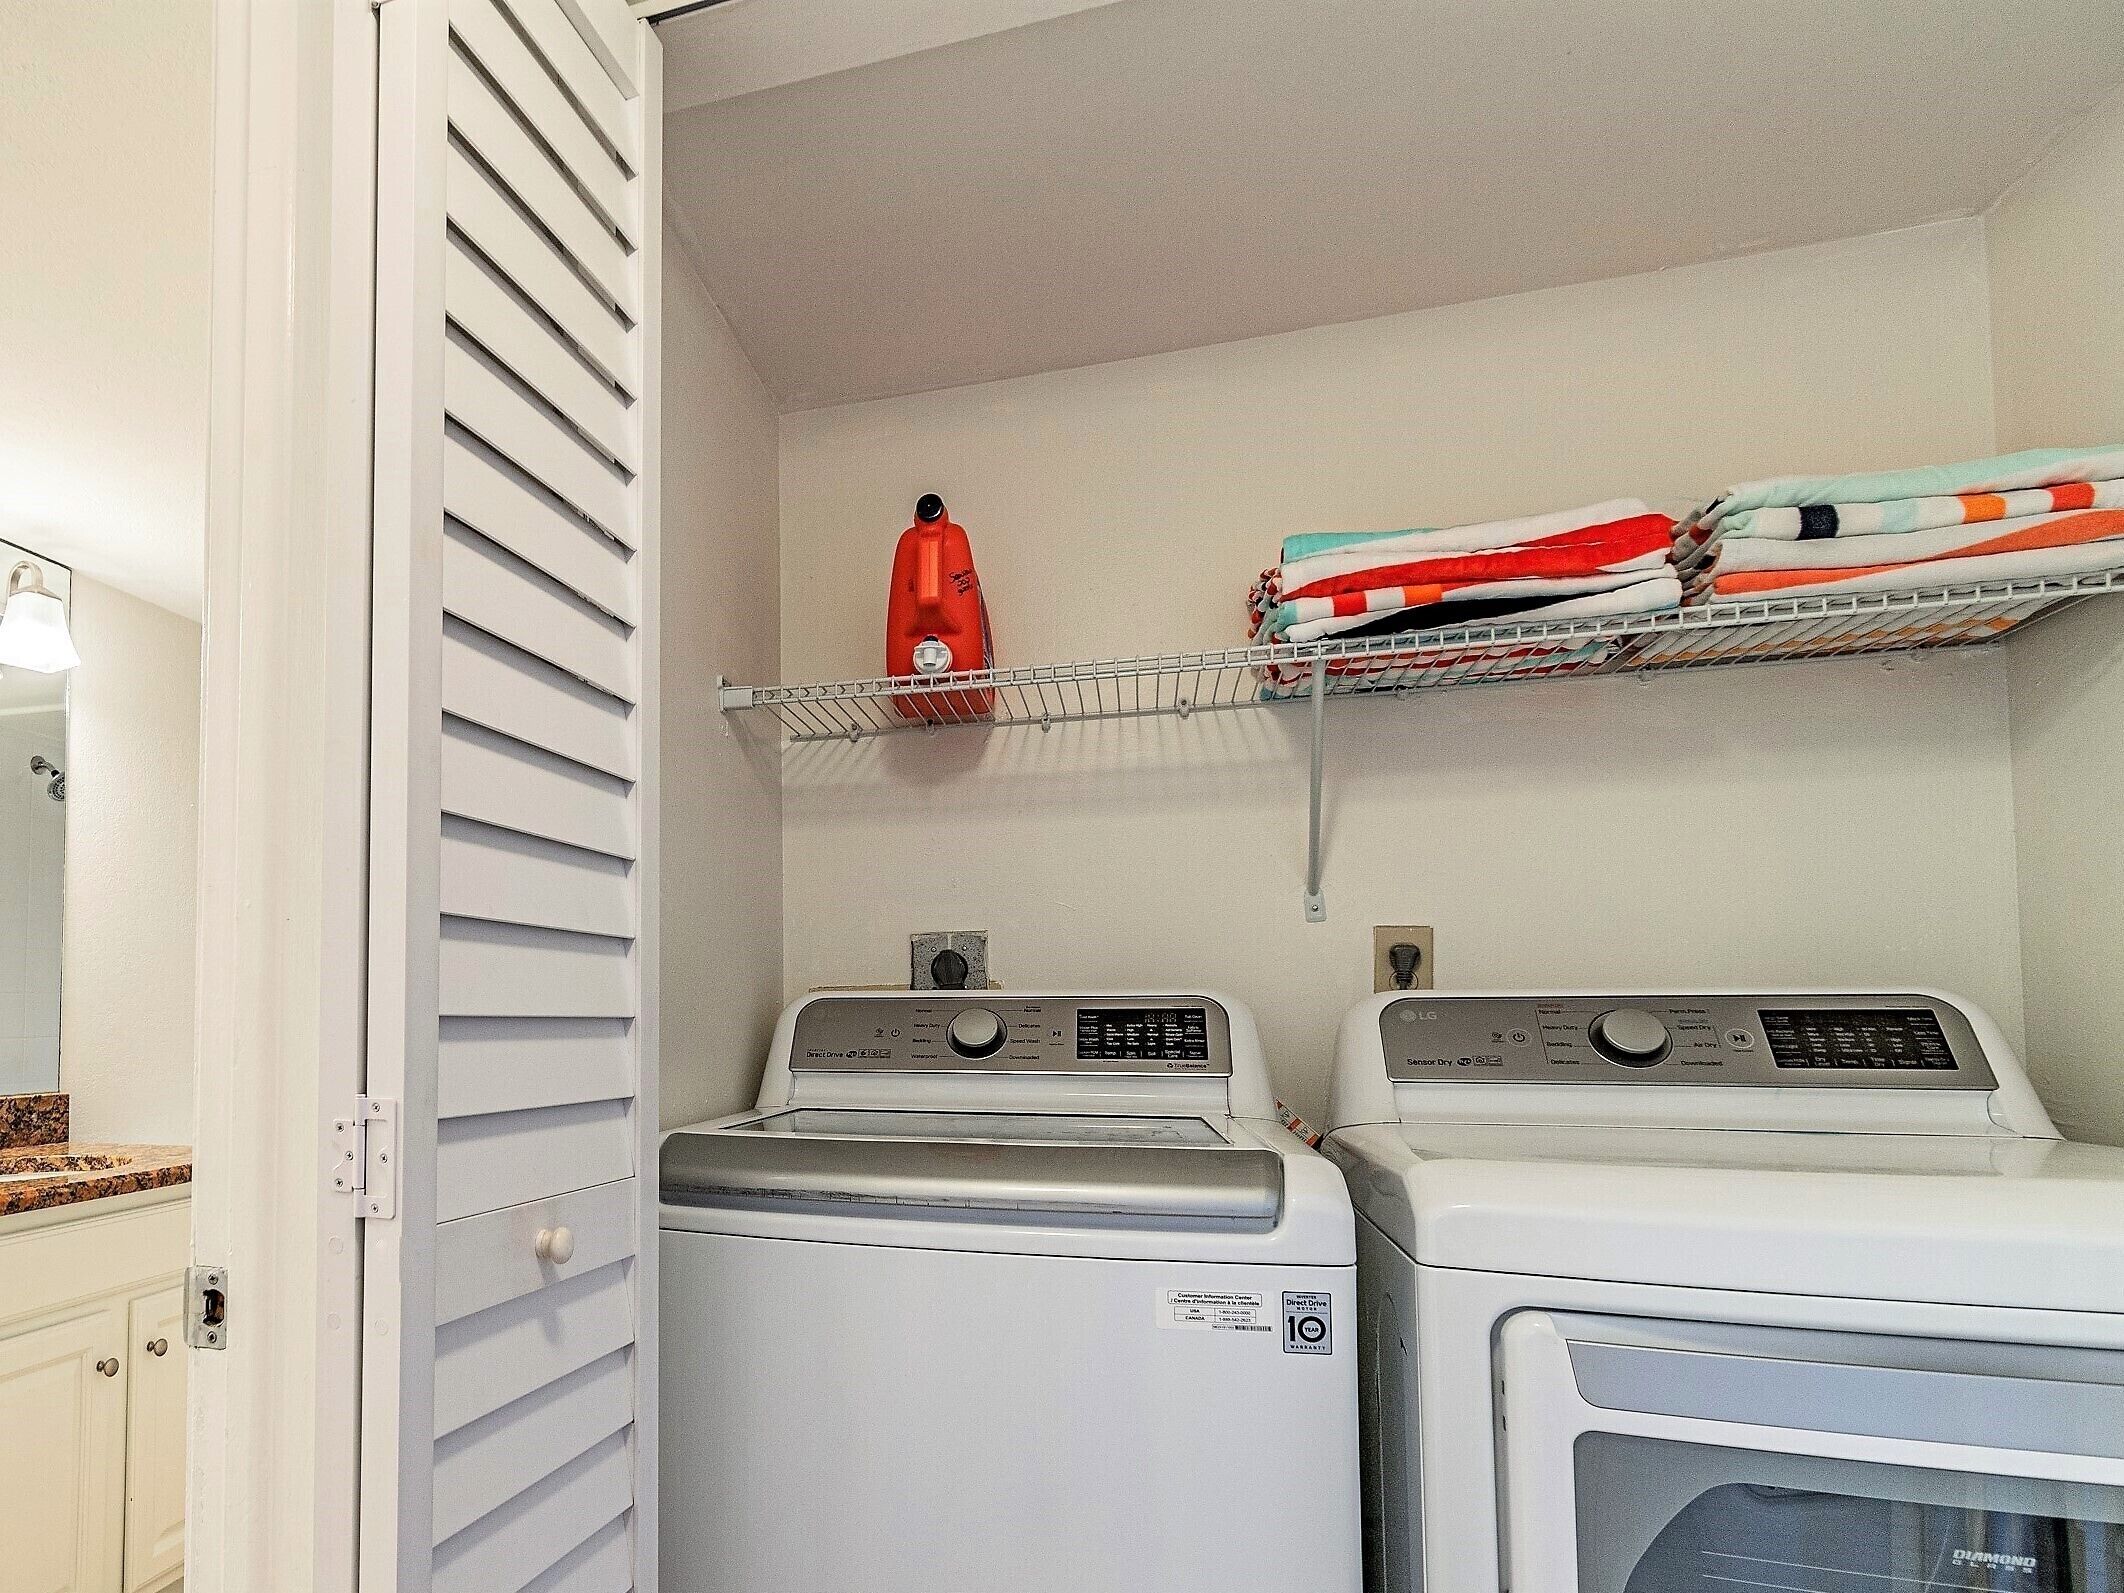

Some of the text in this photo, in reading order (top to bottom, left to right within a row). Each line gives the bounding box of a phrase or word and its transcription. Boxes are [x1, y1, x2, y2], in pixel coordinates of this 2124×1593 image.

[1418, 1011, 1437, 1020] LG
[1407, 1058, 1436, 1066] Sensor
[1437, 1058, 1453, 1067] Dry
[1287, 1315, 1327, 1343] 10
[1952, 1549, 2036, 1568] DIAMOND
